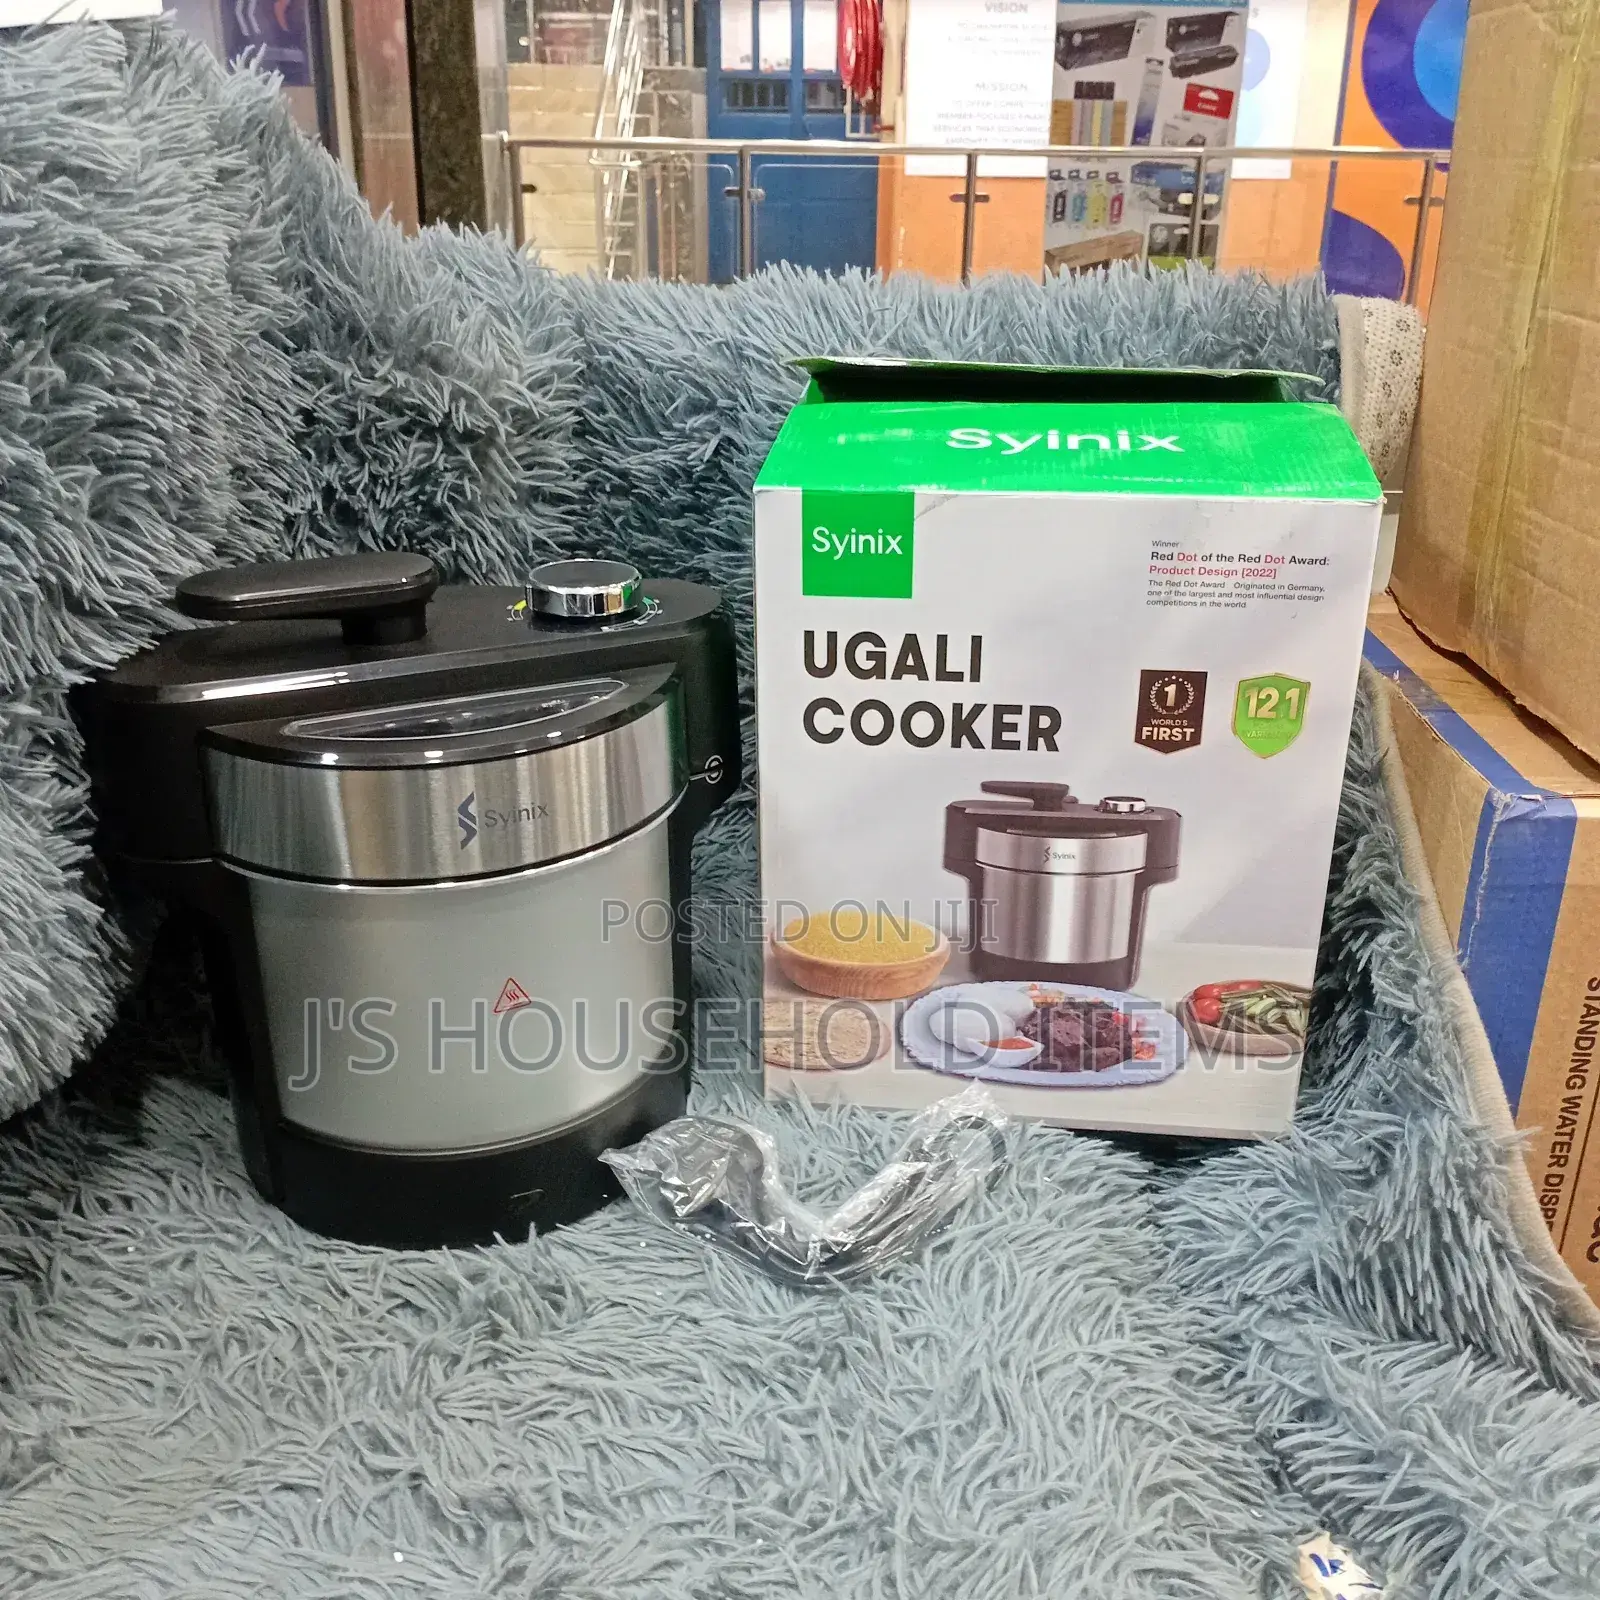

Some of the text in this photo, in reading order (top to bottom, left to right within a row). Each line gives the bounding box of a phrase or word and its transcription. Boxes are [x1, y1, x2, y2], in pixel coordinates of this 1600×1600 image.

[984, 1, 1029, 13] VISION
[975, 82, 1028, 92] MISSION
[946, 428, 1185, 455] Syinix
[811, 526, 903, 560] Syinix
[1151, 540, 1180, 548] Winner
[1151, 551, 1330, 566] Red Dot of the Red Dot Award:
[1149, 565, 1277, 579] Product Design [2022]
[1149, 579, 1163, 587] The
[1200, 581, 1226, 589] Award
[1233, 582, 1276, 591] Originated
[1164, 589, 1173, 597] of
[1188, 590, 1216, 599] largest
[1257, 592, 1295, 600] influential
[1297, 594, 1325, 603] design
[1146, 600, 1198, 608] competitions
[1199, 600, 1207, 608] in
[1209, 600, 1222, 608] the
[803, 630, 983, 683] UGALI
[1164, 684, 1177, 707] 1
[803, 697, 1062, 752] COOKER
[1141, 727, 1195, 742] FIRST
[484, 801, 549, 830] Syinix
[1052, 852, 1077, 860] Syinix
[1547, 1095, 1583, 1168] WATER
